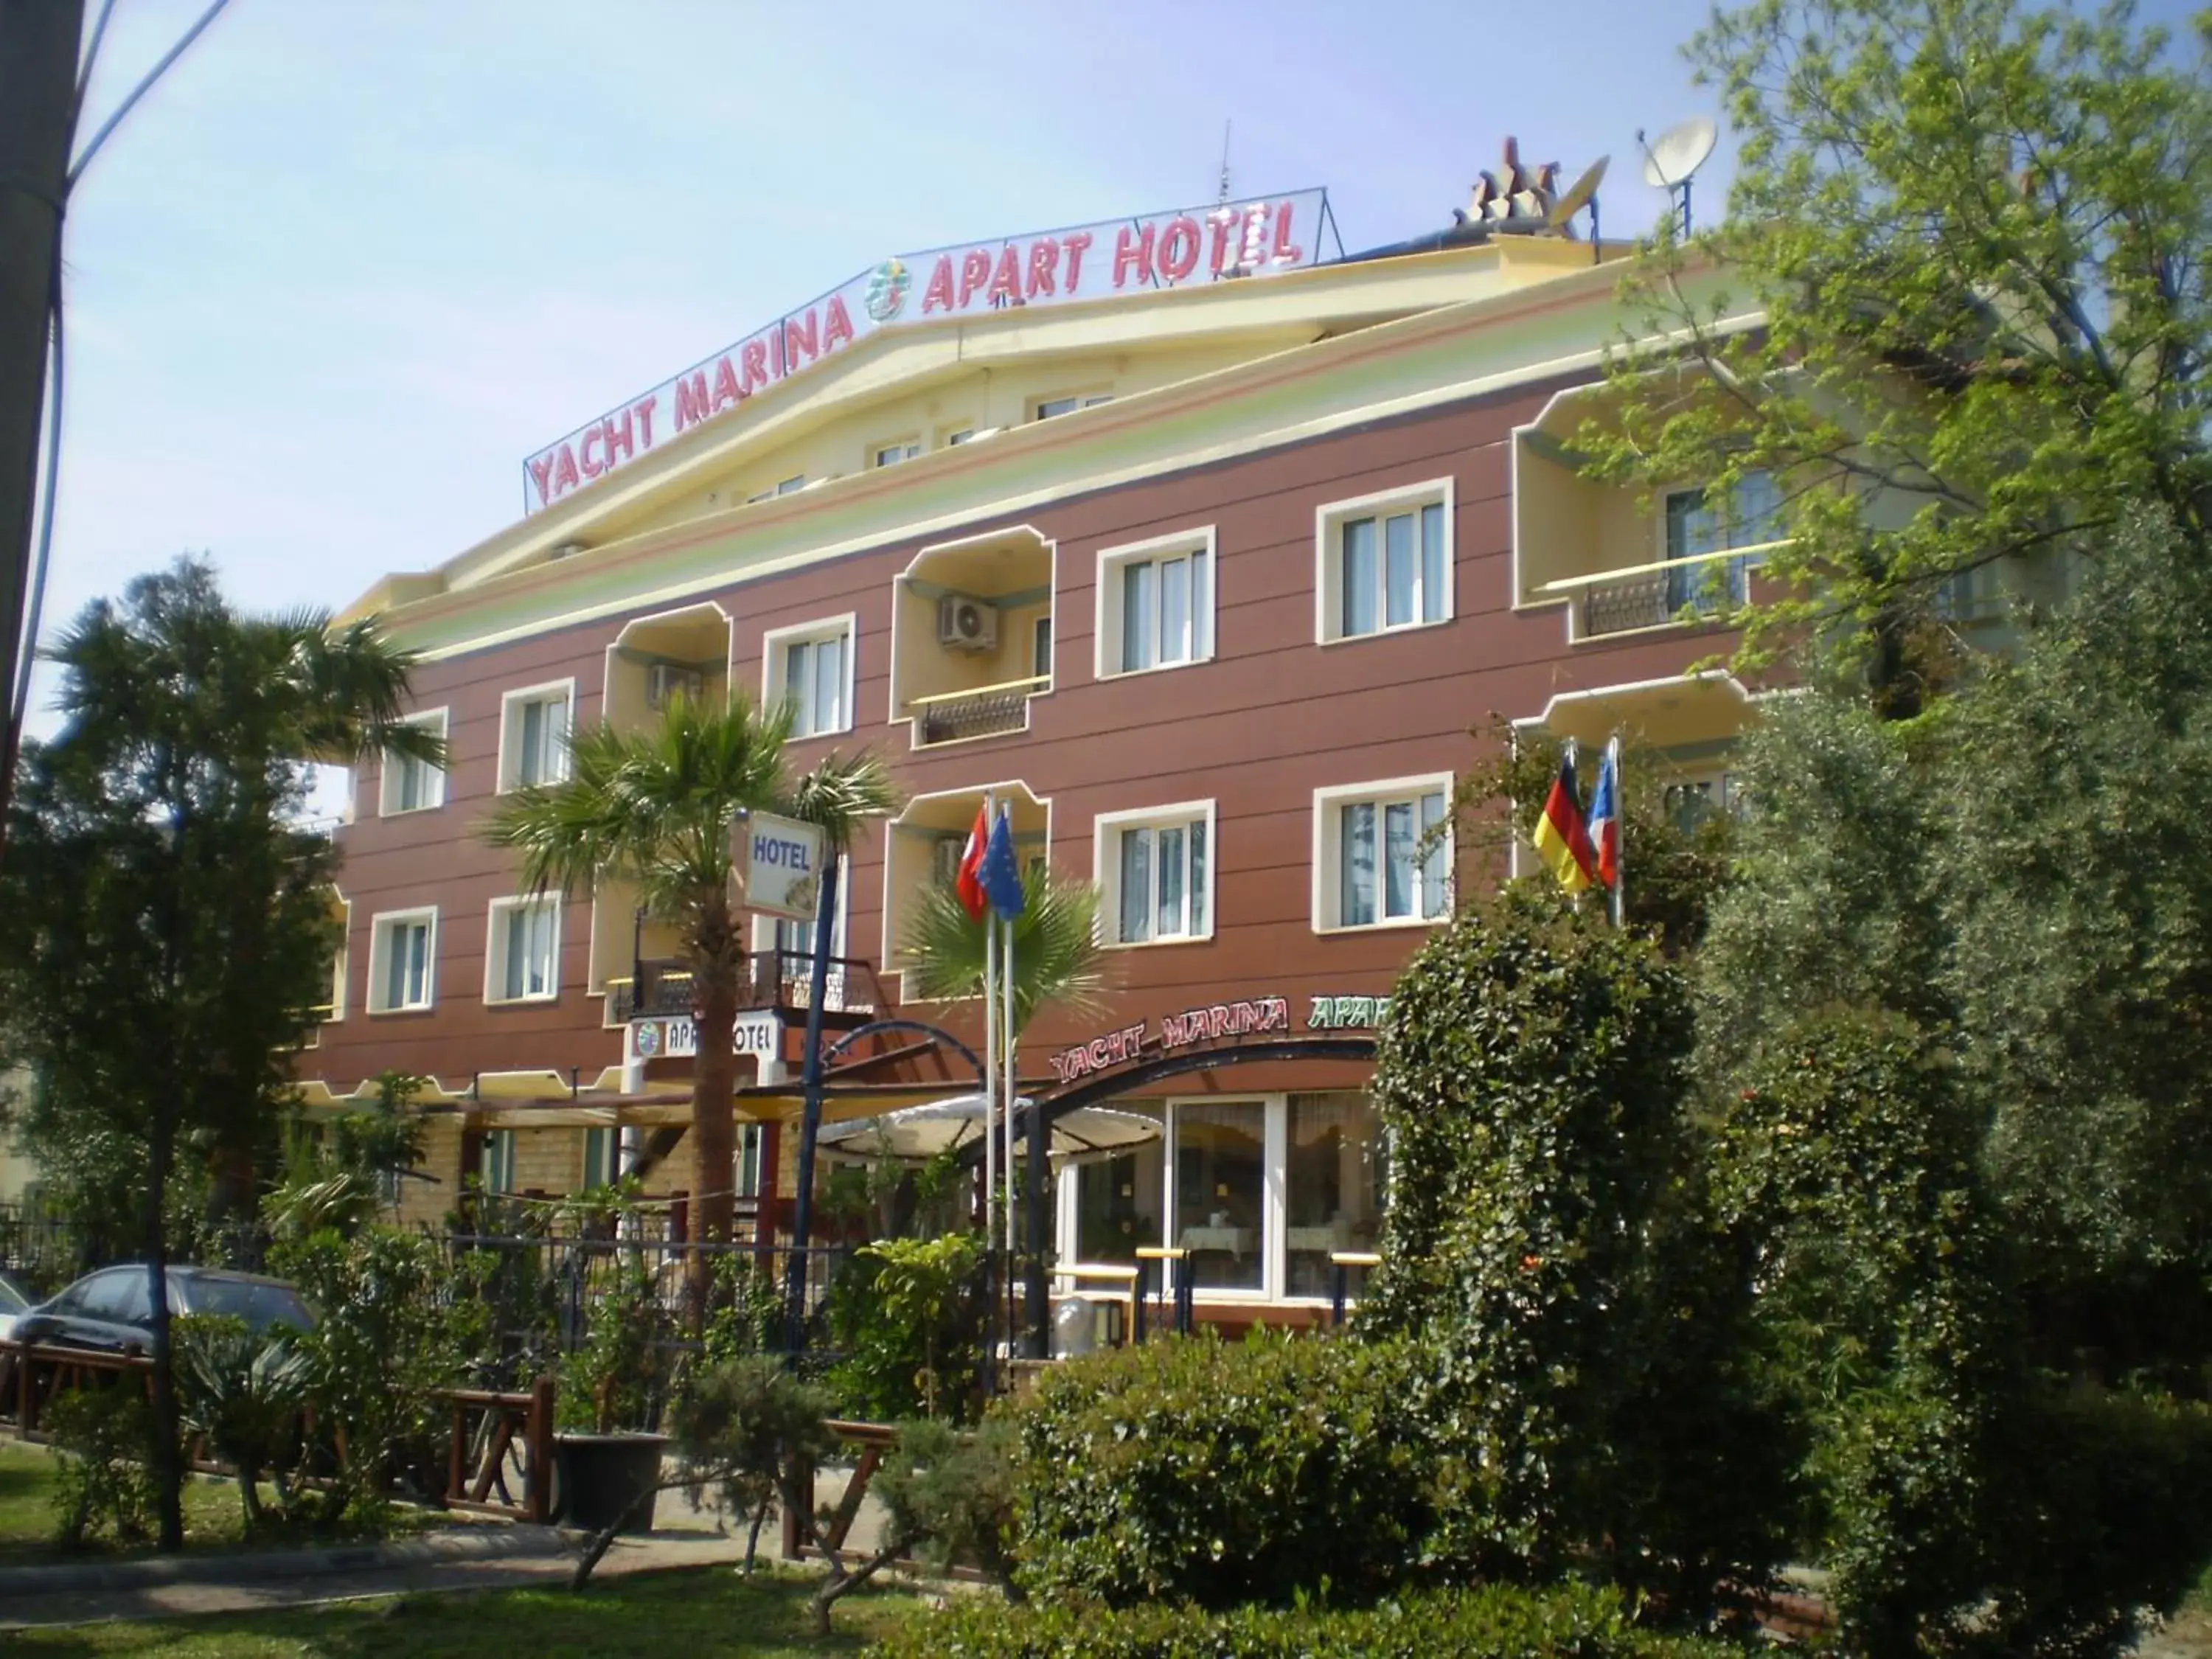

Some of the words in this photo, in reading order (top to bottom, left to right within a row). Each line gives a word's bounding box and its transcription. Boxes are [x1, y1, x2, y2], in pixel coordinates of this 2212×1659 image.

[530, 396, 656, 504] YACHT
[674, 293, 854, 433] MARINA
[922, 232, 1091, 314] APART
[1113, 201, 1301, 288] HOTEL
[754, 835, 810, 872] HOTEL
[733, 1023, 771, 1051] OTEL
[1050, 1023, 1146, 1085] YACHT
[1162, 996, 1289, 1048] MARINA
